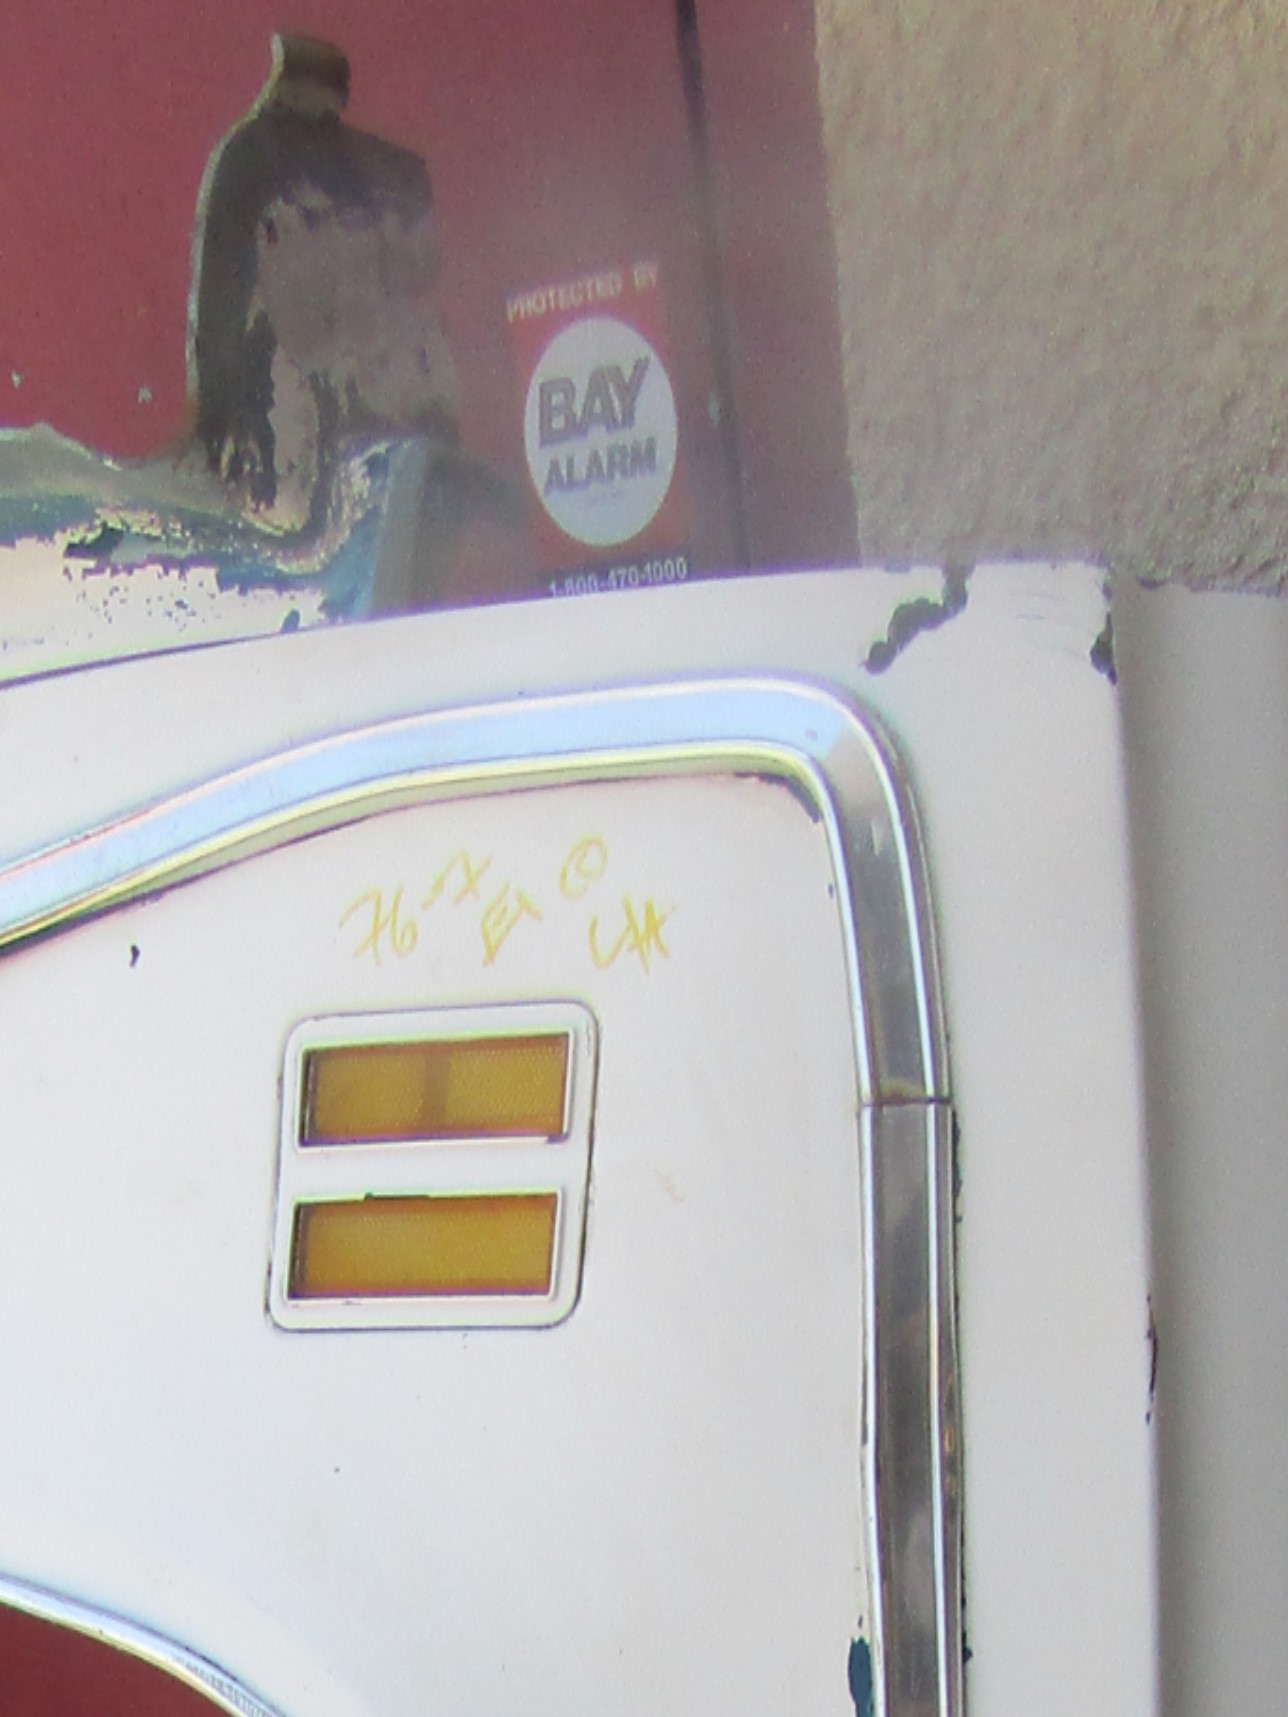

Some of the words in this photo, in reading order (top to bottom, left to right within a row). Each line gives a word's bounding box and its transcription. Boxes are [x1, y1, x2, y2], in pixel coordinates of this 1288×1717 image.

[506, 270, 622, 322] PROTECTED
[633, 261, 660, 290] BY
[538, 355, 651, 448] BAY
[544, 436, 658, 497] ALARM
